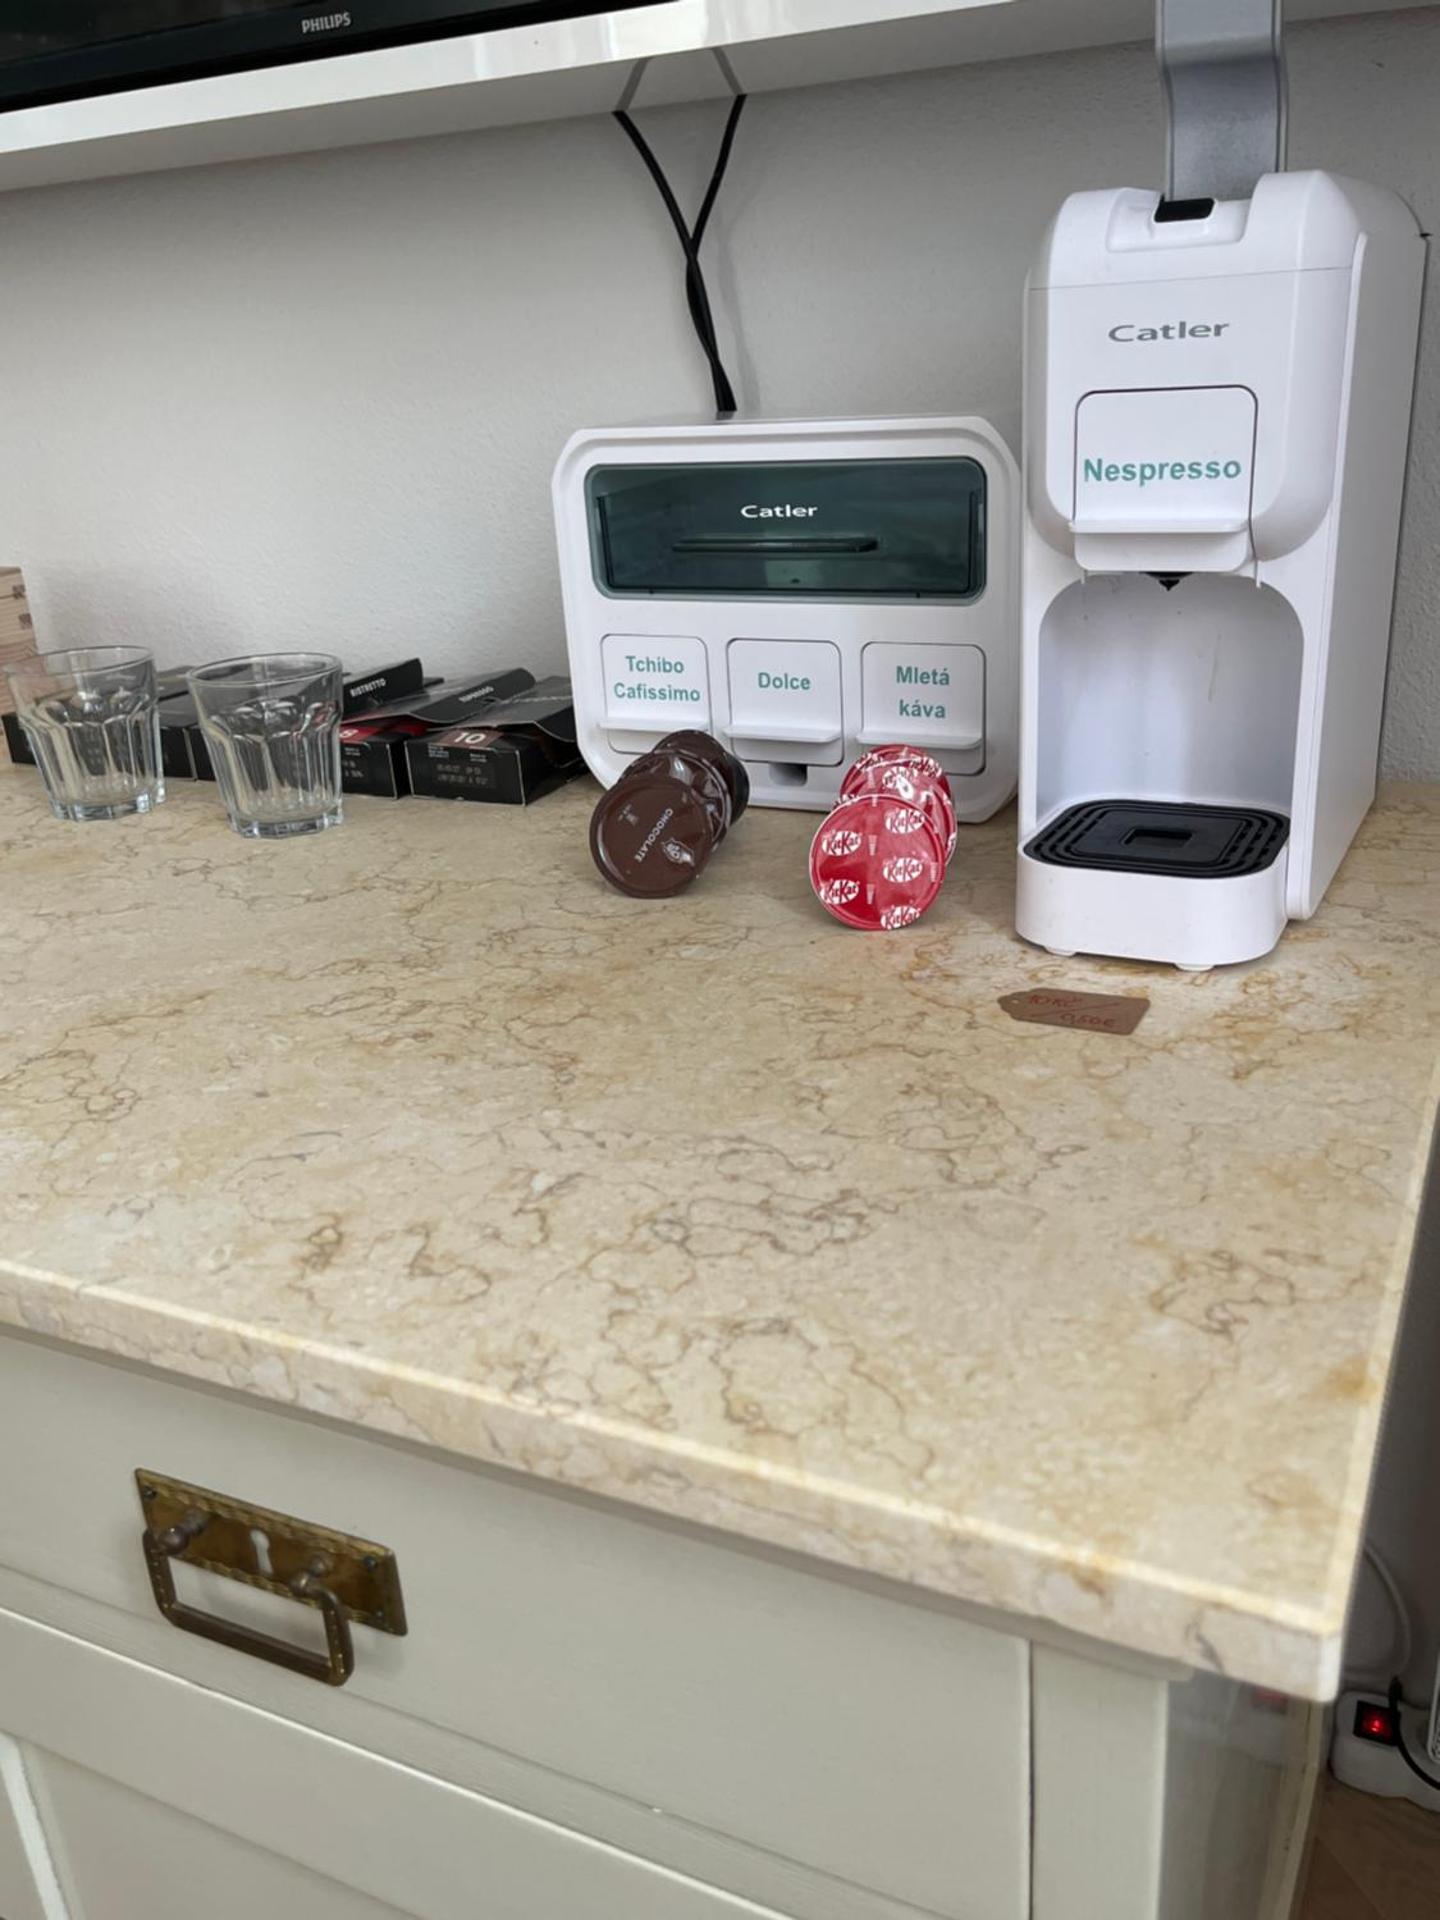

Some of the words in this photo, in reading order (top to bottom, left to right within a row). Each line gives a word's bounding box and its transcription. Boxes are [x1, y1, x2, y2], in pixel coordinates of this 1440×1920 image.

[301, 12, 351, 34] PHILIPS
[1108, 321, 1230, 342] Catler
[1083, 457, 1242, 487] Nespresso
[740, 504, 818, 519] Catler
[626, 655, 685, 674] Tchibo
[757, 672, 811, 690] Dolce
[896, 665, 950, 686] Mletá
[350, 677, 386, 697] RISTRETTO
[614, 682, 701, 702] Cafissimo
[899, 699, 946, 719] káva
[453, 731, 487, 745] 10
[633, 808, 674, 863] CHOCOLATE
[822, 830, 862, 857] KitKat
[883, 857, 924, 883] KitKat
[820, 879, 859, 905] KitKat
